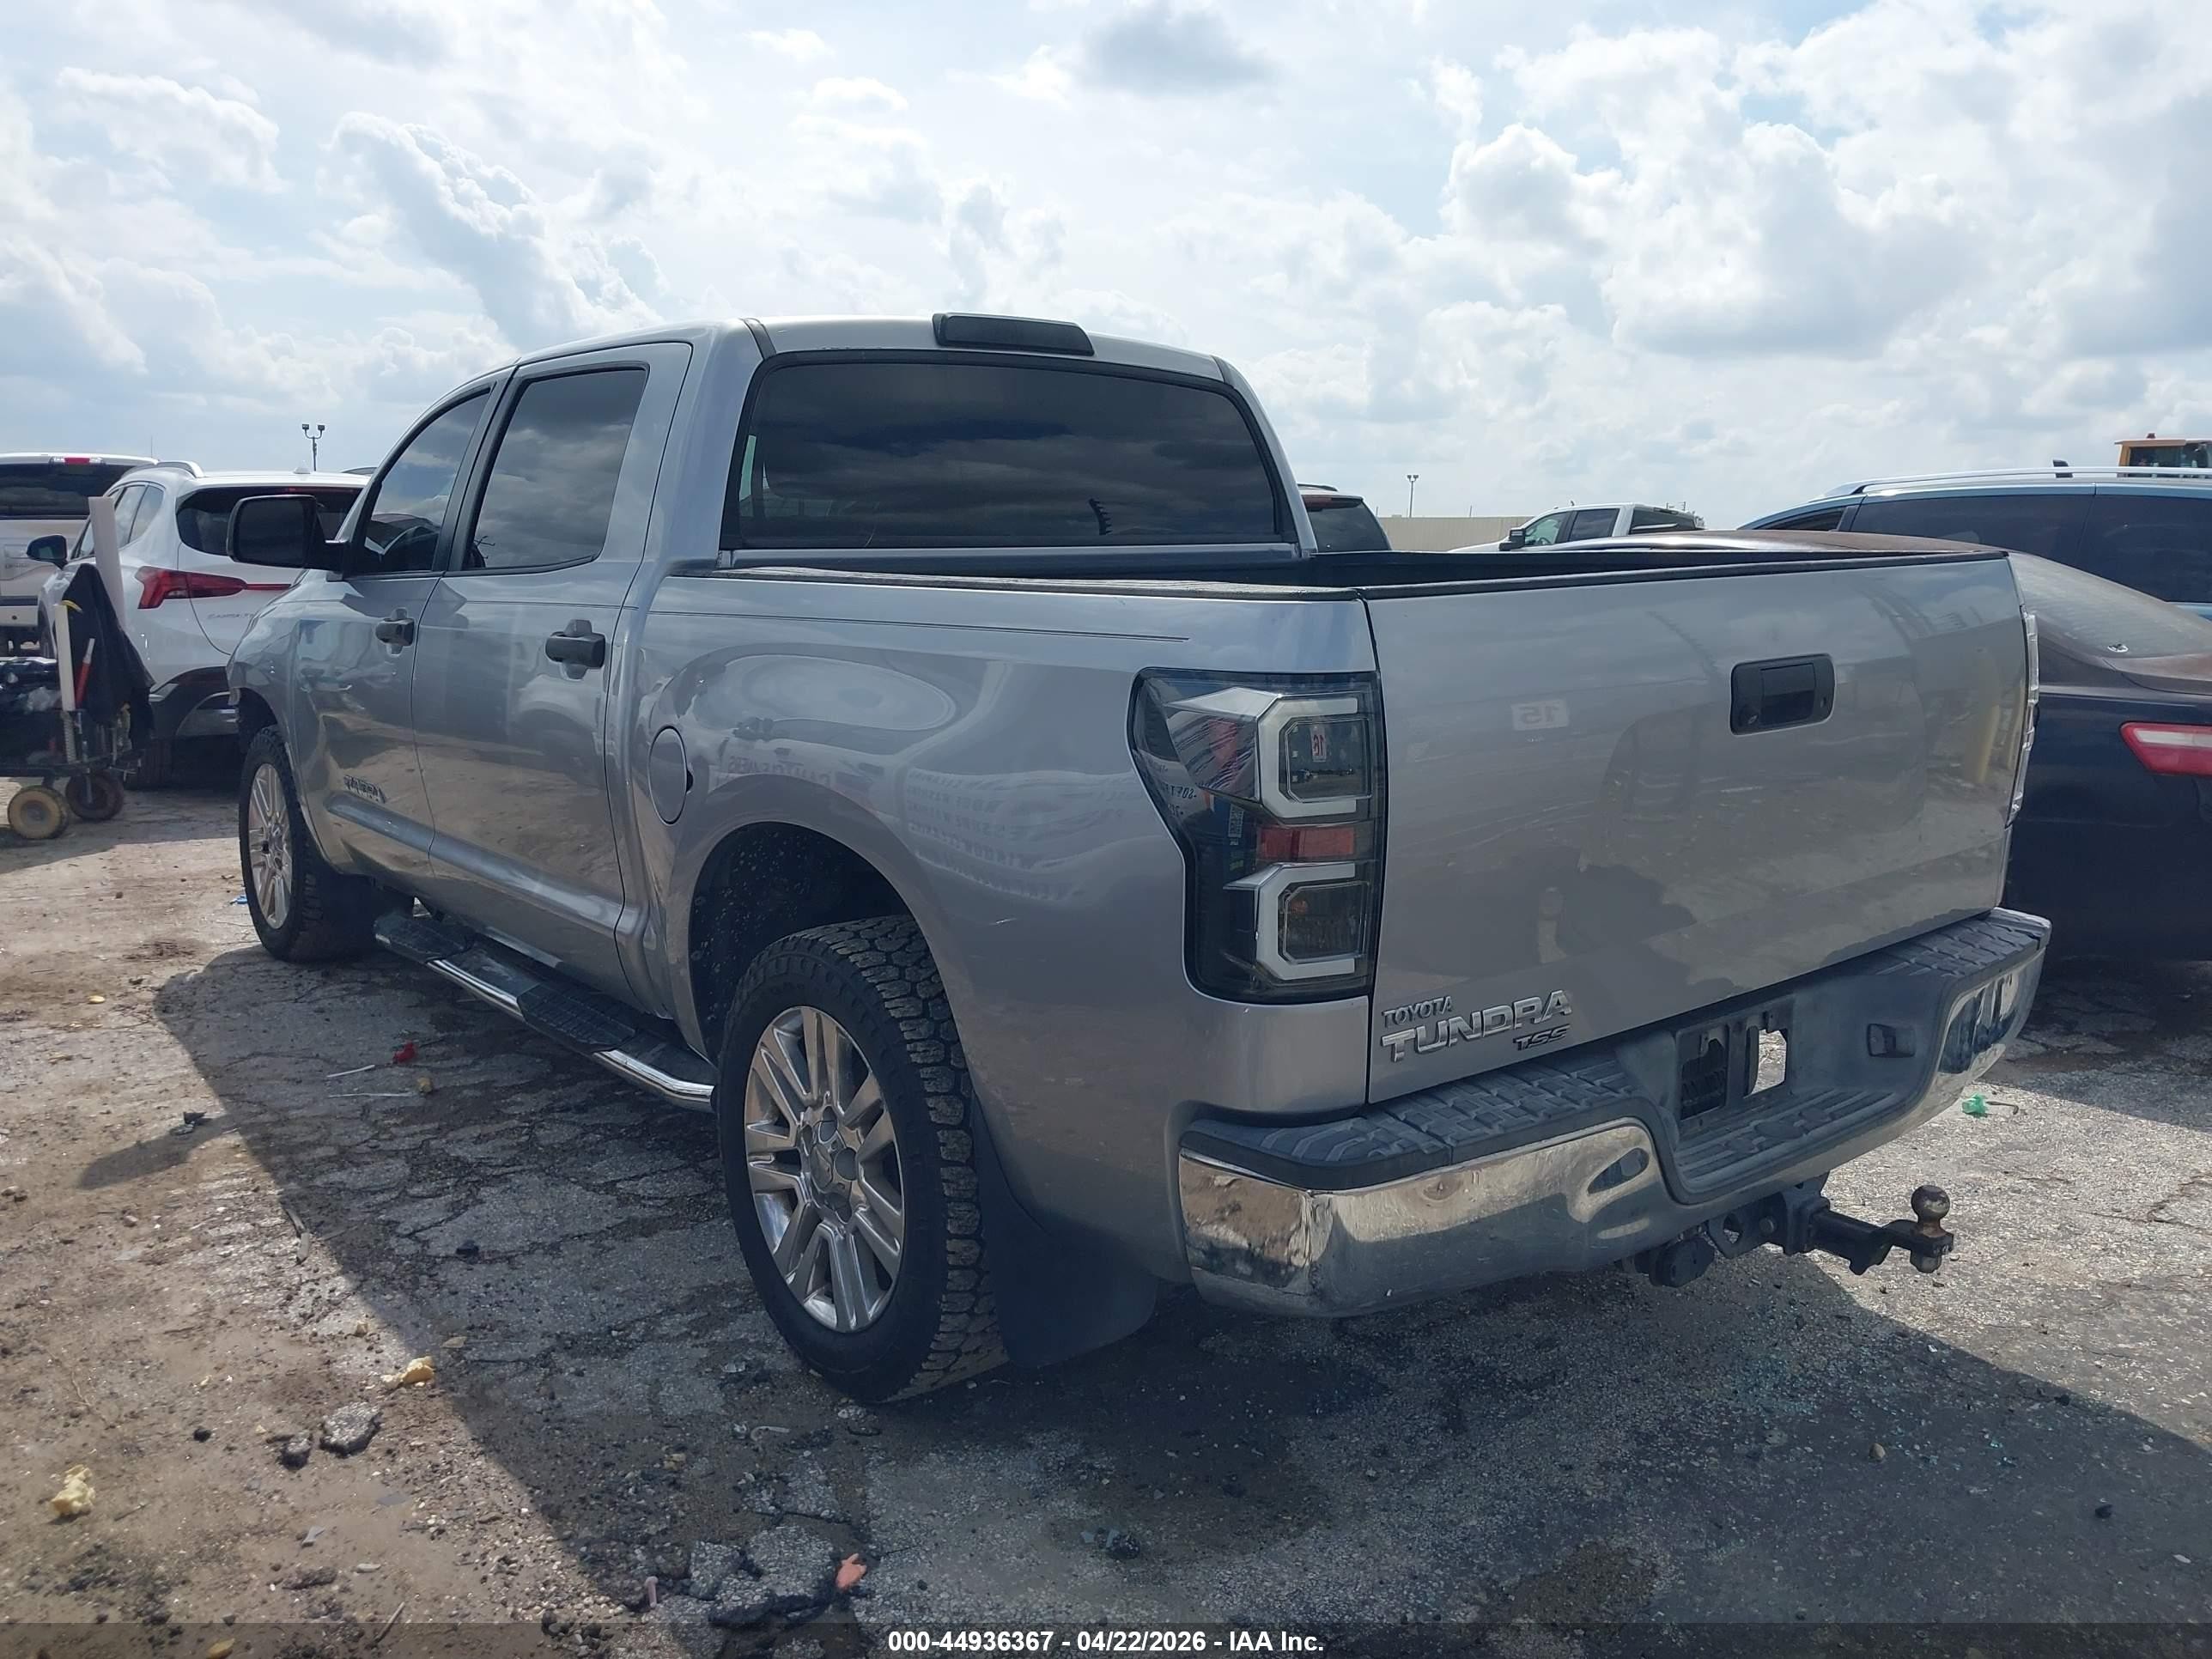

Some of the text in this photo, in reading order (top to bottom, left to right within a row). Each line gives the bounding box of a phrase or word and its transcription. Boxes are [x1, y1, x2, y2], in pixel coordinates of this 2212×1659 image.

[1381, 989, 1573, 1062] TUNDRA
[1382, 995, 1453, 1029] TOYOTA
[1513, 1024, 1571, 1052] TSS
